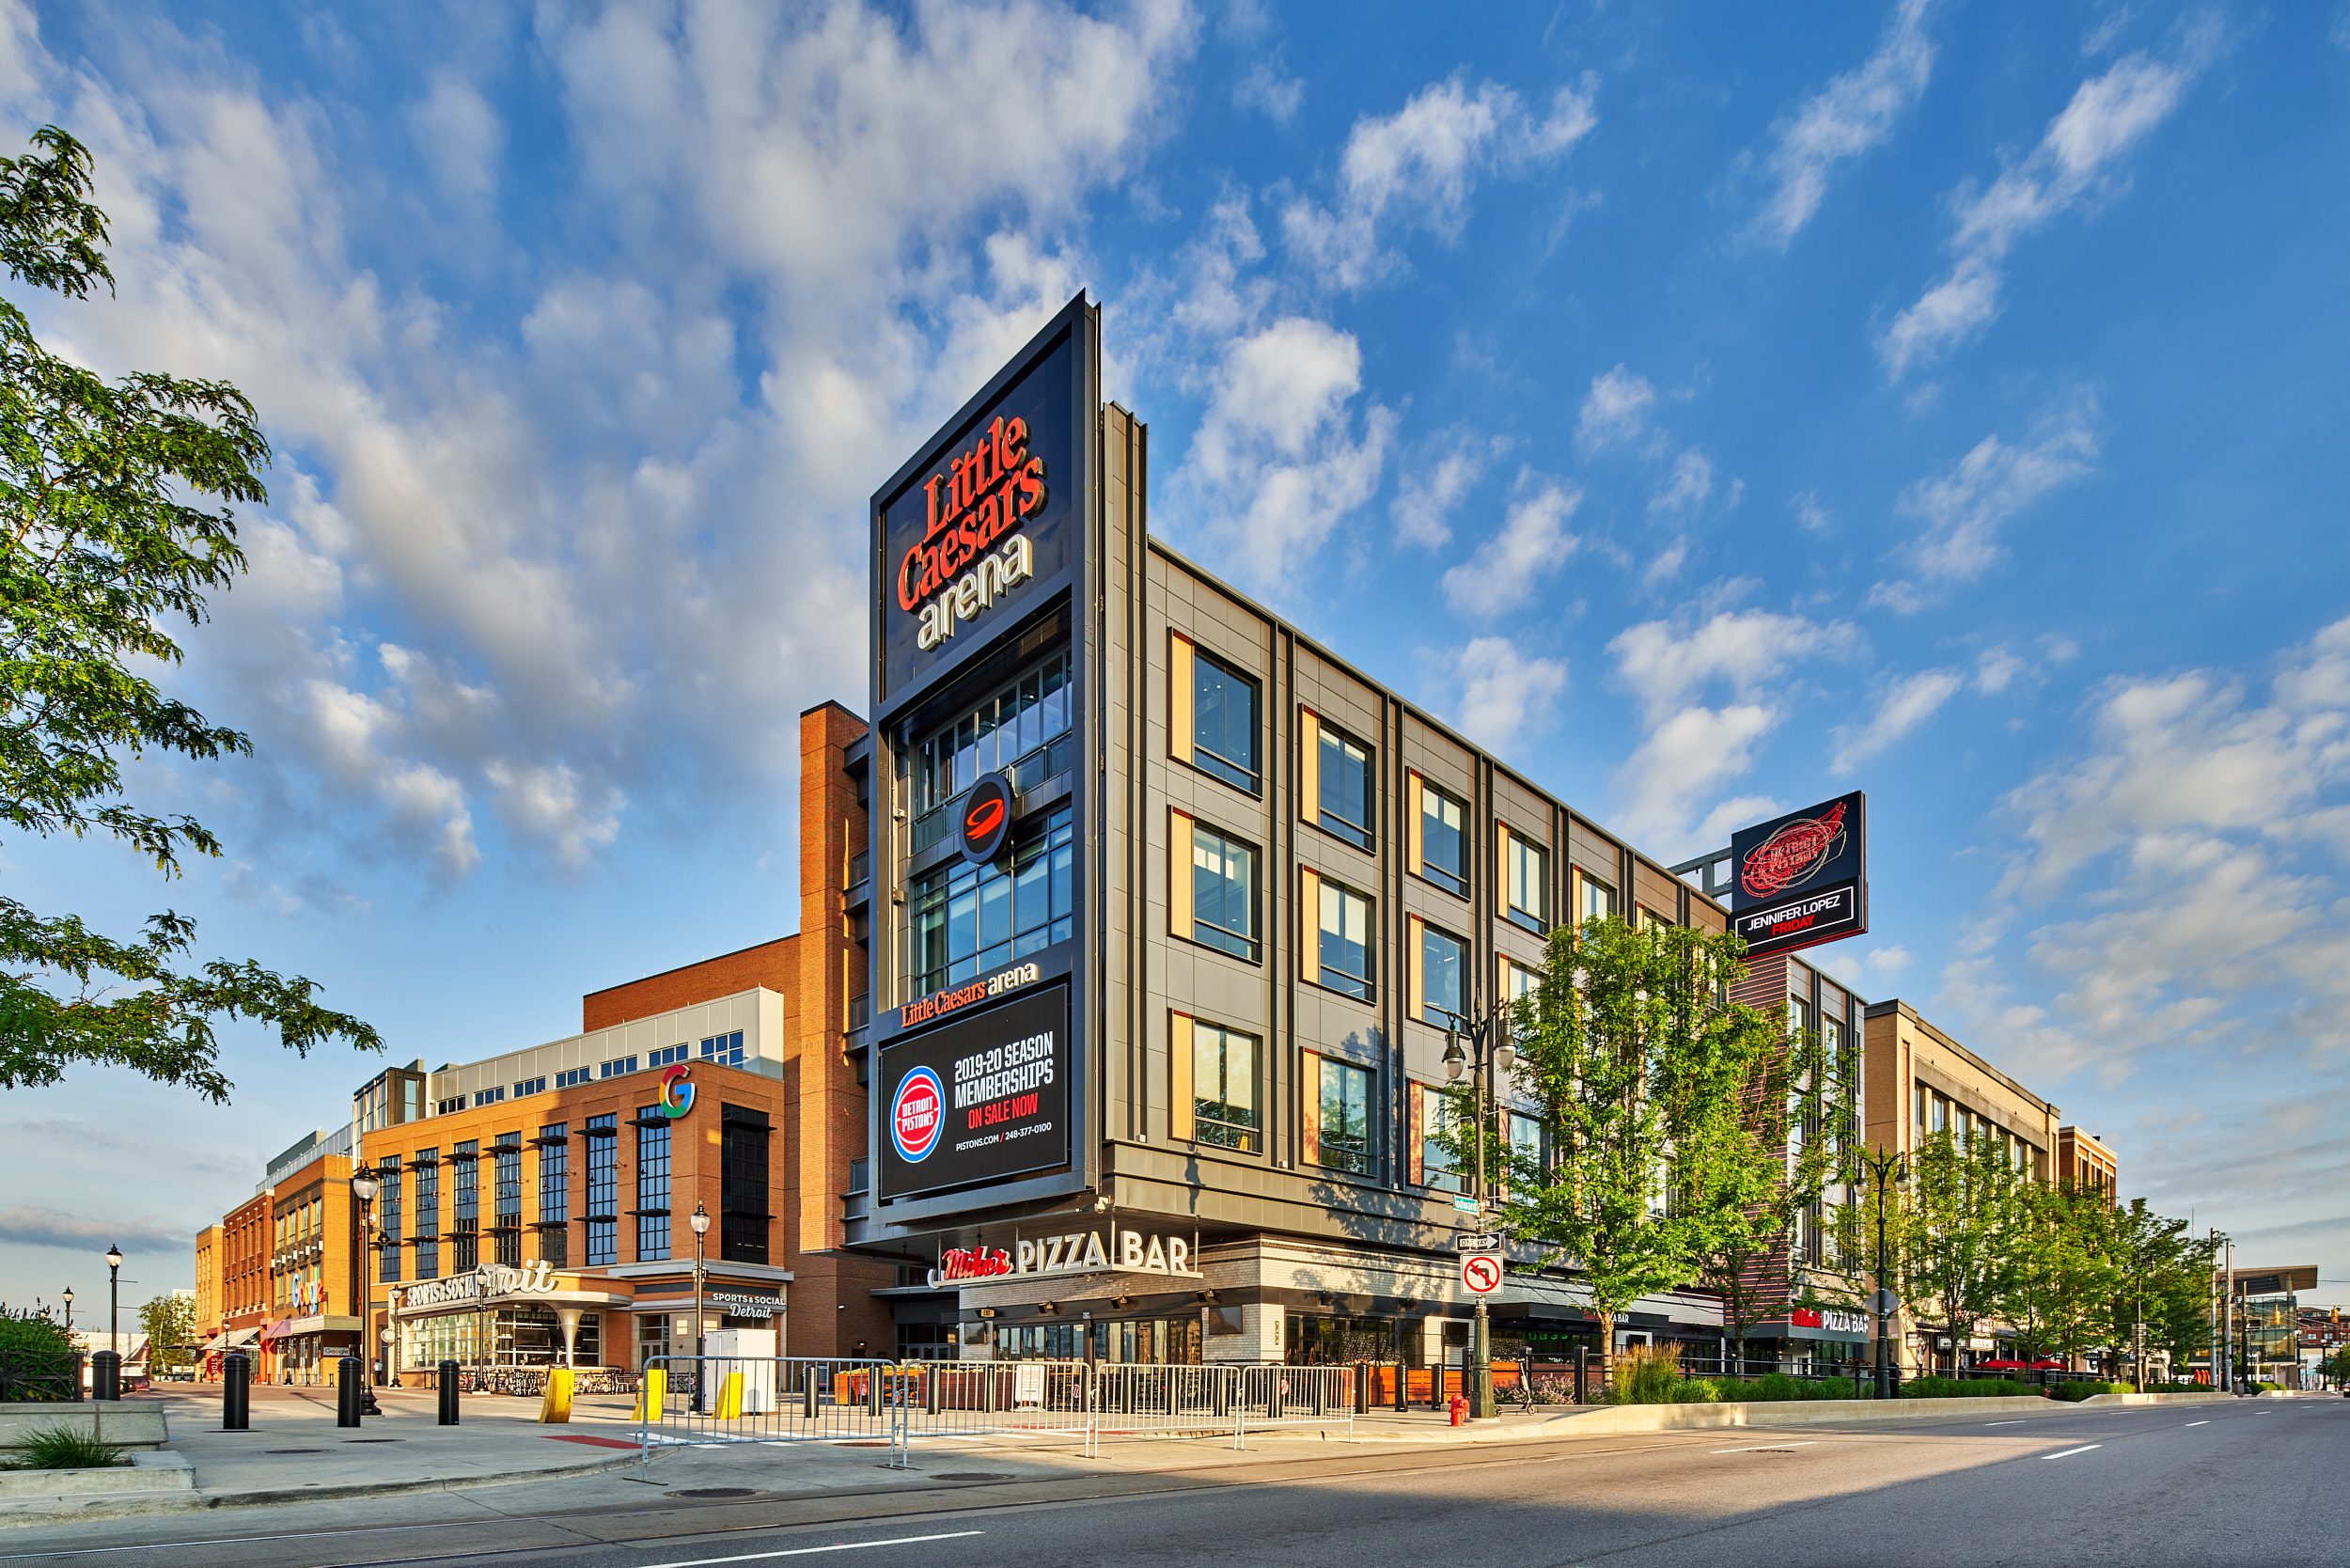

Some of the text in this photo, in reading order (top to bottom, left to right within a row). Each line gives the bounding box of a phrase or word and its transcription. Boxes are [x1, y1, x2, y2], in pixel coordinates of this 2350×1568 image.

[923, 416, 1029, 543] Little
[898, 457, 1046, 611] Caesars
[917, 533, 1033, 651] arena
[1747, 895, 1841, 932] JENNIFER LOPEZ
[1771, 915, 1815, 936] FRIDAY
[901, 962, 1039, 1027] Little Caesars arena
[955, 1031, 1054, 1082] 2019-20 SEASON
[955, 1058, 1054, 1108] MEMBERSHIPS
[901, 1096, 933, 1117] DETROIT
[901, 1110, 933, 1133] PISTONS
[968, 1092, 1039, 1129] ON SALE NOW
[956, 1135, 999, 1152] PISTONS.COM
[1005, 1121, 1052, 1141] 248-377-0100
[1018, 1231, 1107, 1274] PIZZA
[1120, 1230, 1188, 1272] BAR
[292, 1264, 325, 1315] Google
[407, 1282, 440, 1307] SPORTS
[713, 1293, 748, 1303] SPORTS
[755, 1296, 786, 1306] SOCIAL
[729, 1303, 773, 1318] Detroit
[1618, 1314, 1629, 1324] BAR
[1823, 1309, 1851, 1332] PIZZA
[324, 1347, 349, 1356] Google
